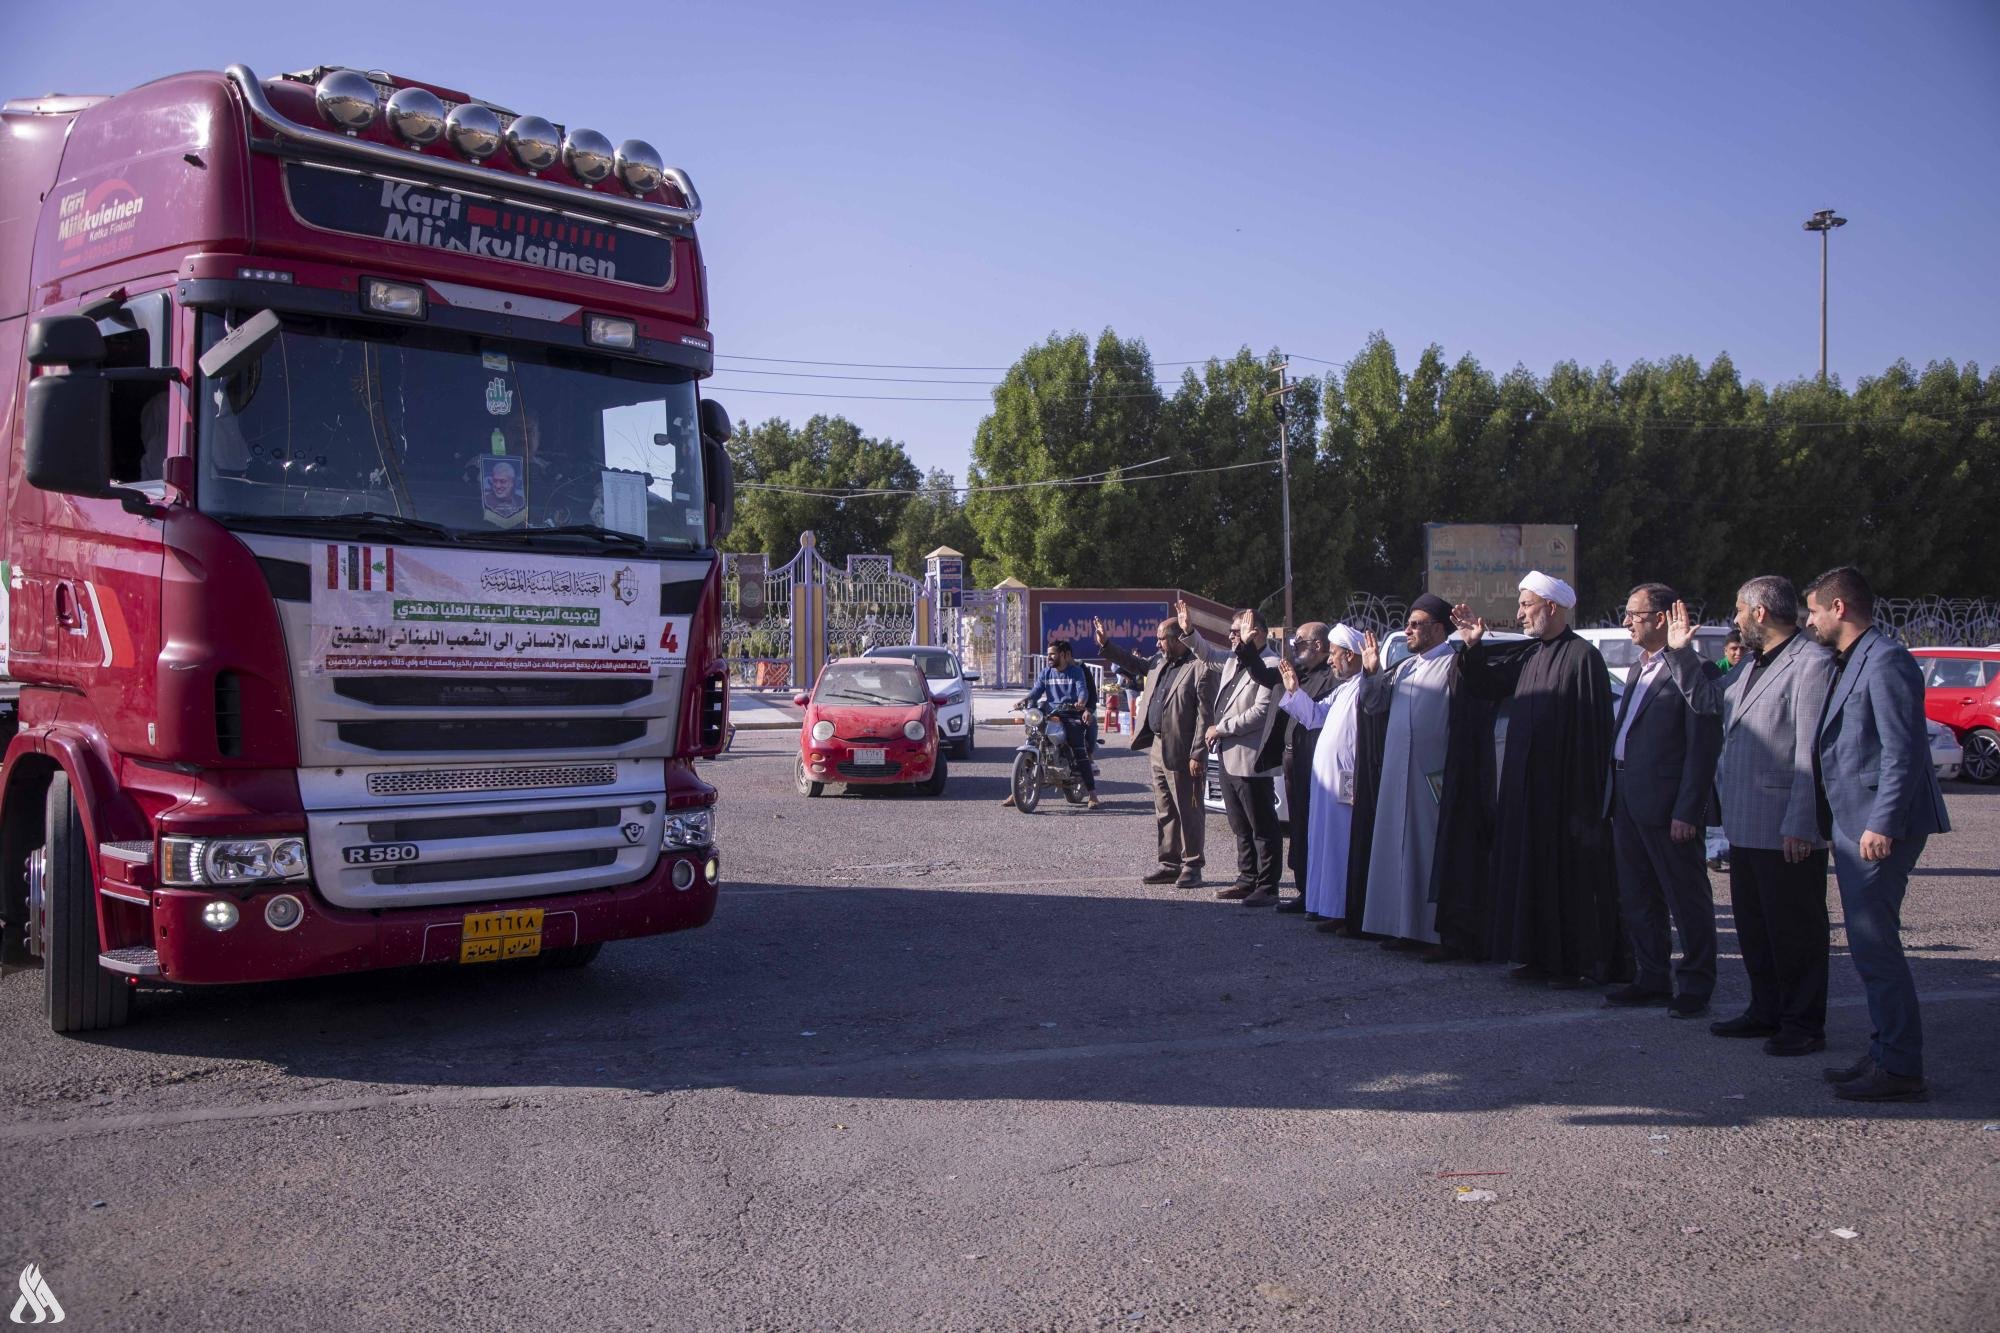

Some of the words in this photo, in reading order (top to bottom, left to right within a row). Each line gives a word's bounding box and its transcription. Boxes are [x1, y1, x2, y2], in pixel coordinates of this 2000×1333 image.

[59, 188, 86, 219] Kari
[380, 180, 462, 220] Kari
[397, 602, 439, 620] نهتدي
[441, 603, 471, 619] العليا
[473, 605, 511, 620] الدينية
[512, 606, 560, 622] المرجعية
[561, 609, 598, 624] بتوجيه
[331, 625, 386, 649] الشقيق
[388, 627, 444, 651] اللبناني
[446, 628, 491, 650] الشعب
[572, 633, 609, 654] الدعم
[611, 634, 646, 654] قوافل
[660, 622, 678, 653] 4
[349, 848, 366, 863] R
[369, 845, 417, 862] 580
